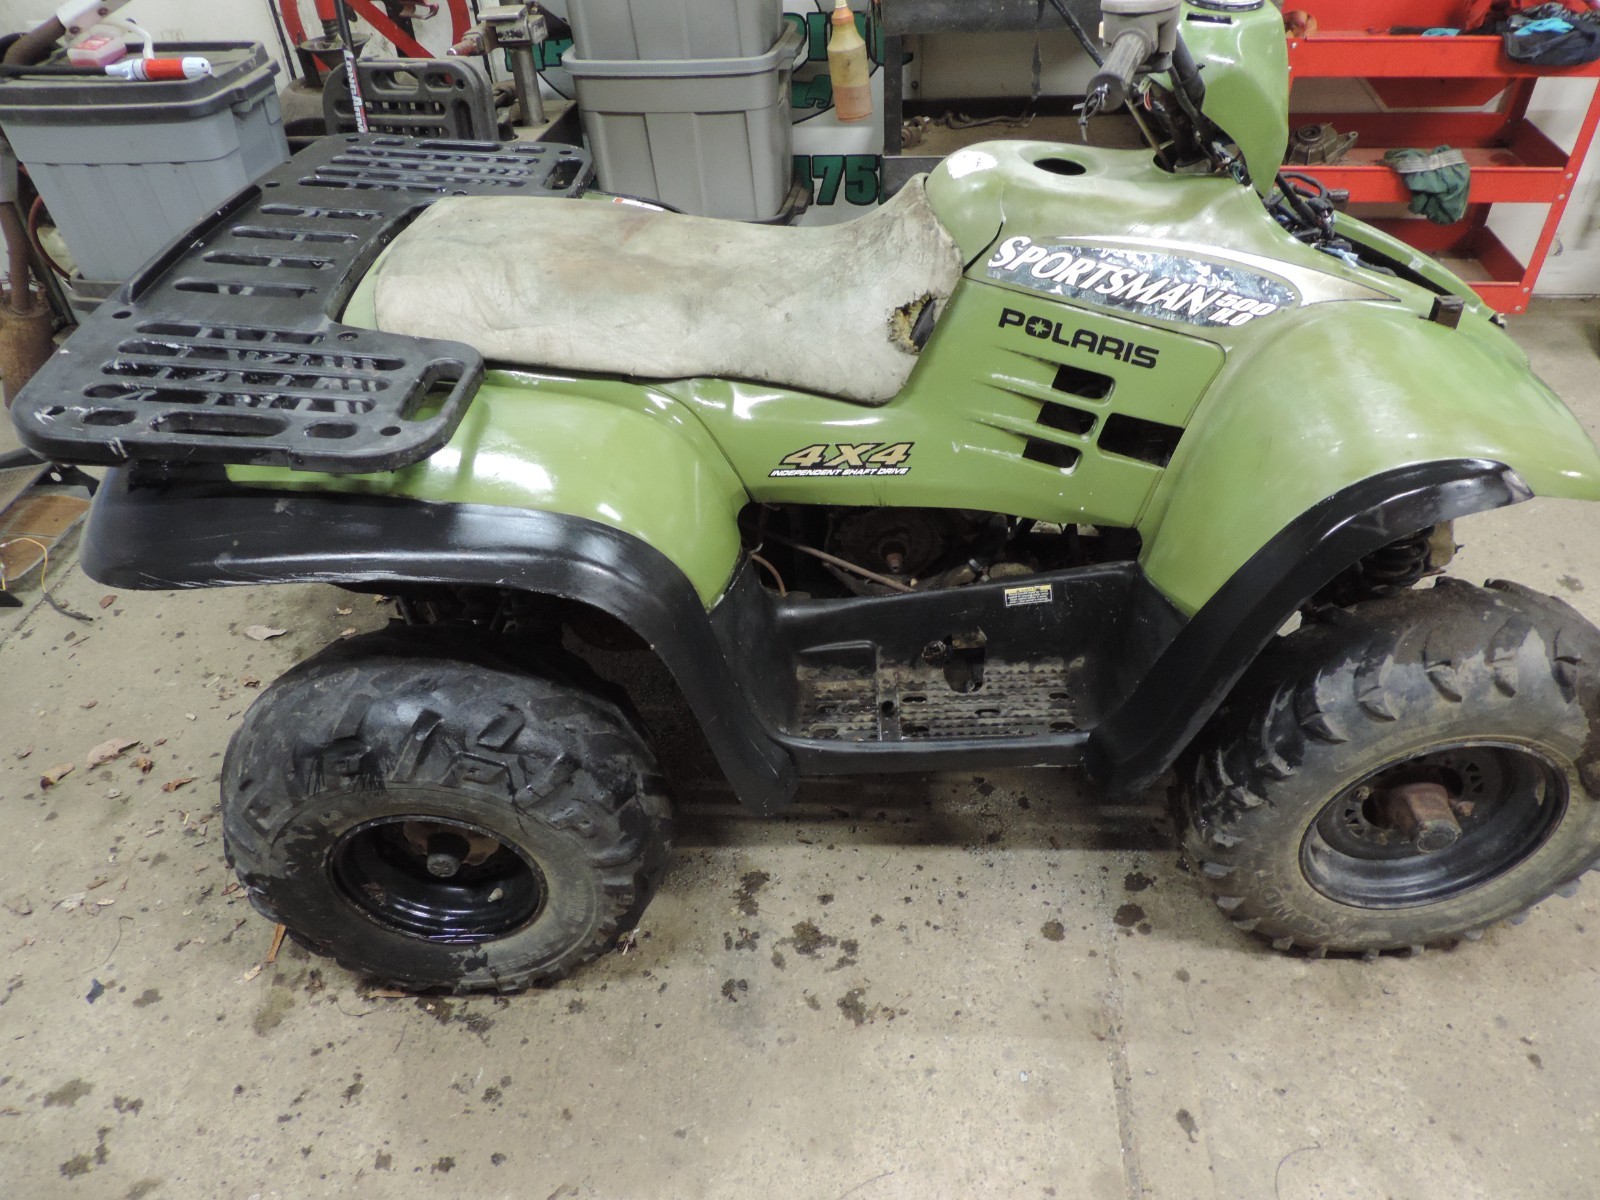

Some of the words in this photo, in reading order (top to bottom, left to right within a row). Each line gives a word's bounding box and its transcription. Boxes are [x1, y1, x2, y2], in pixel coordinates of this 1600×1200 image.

[987, 235, 1224, 316] SPORTSMAN
[1214, 293, 1277, 316] 500
[997, 307, 1160, 370] POLARIS
[770, 468, 844, 477] INDEPENDENT
[841, 468, 878, 477] SHAFT
[876, 467, 908, 476] DRIVE
[778, 441, 915, 468] 4X4
